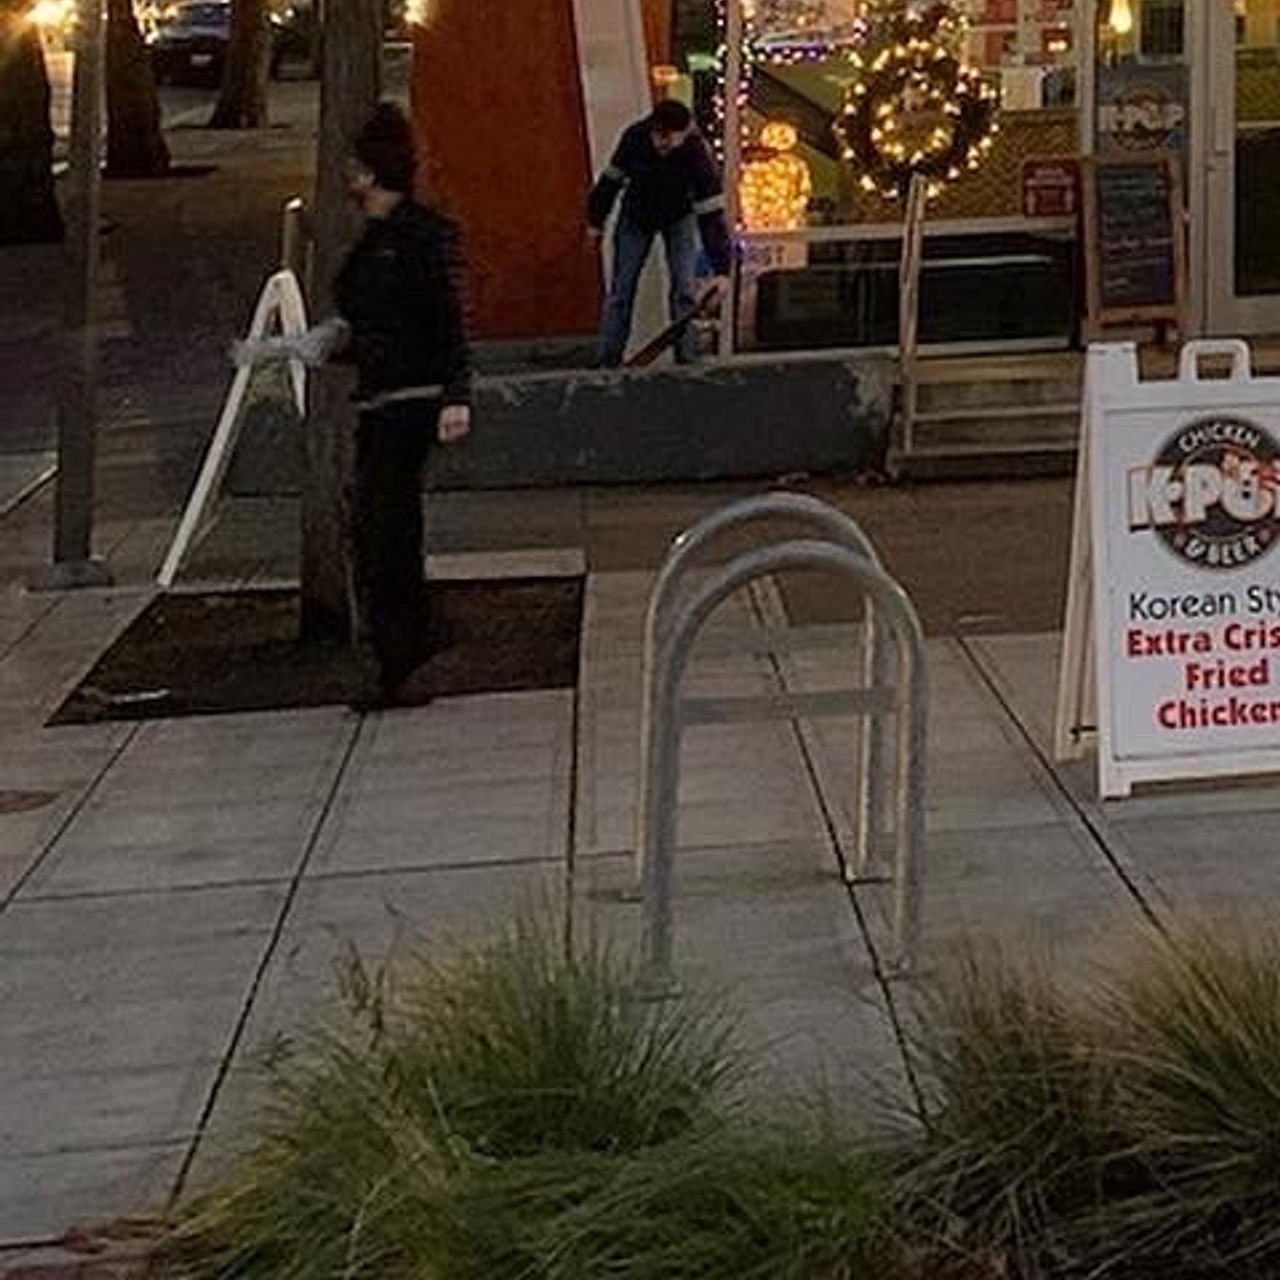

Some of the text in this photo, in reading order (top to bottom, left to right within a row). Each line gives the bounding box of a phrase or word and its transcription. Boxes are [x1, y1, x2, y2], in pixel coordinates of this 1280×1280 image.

[1178, 423, 1261, 452] CHICKEN
[1208, 536, 1262, 564] BEER
[1130, 593, 1236, 620] Korean
[1127, 629, 1212, 657] Extra
[1186, 658, 1270, 690] Fried
